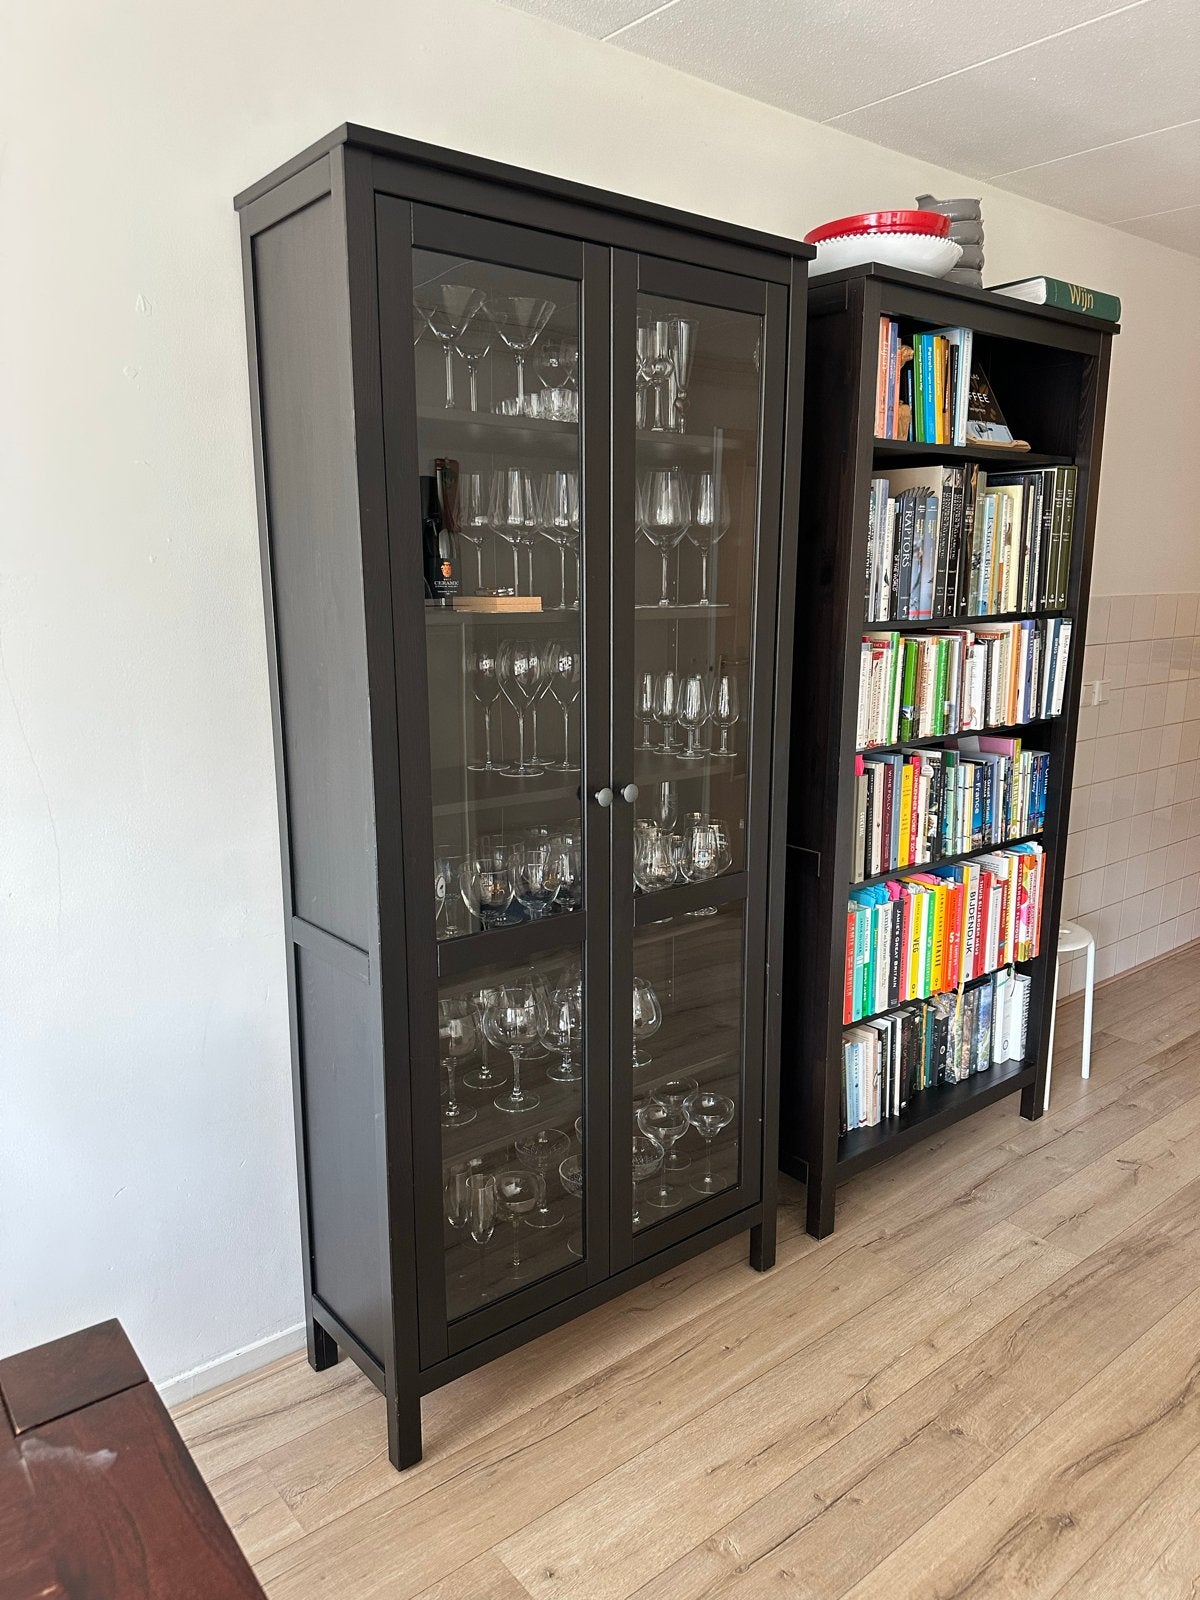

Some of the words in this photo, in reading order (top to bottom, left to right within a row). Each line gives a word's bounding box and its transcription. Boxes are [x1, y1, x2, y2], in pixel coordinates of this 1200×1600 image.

[1068, 284, 1094, 312] Wijn
[968, 392, 990, 404] FFEE
[902, 510, 912, 568] RAPTORS
[985, 516, 994, 557] Extinct
[910, 842, 915, 852] ZO
[966, 891, 977, 955] BIJDENDIJK
